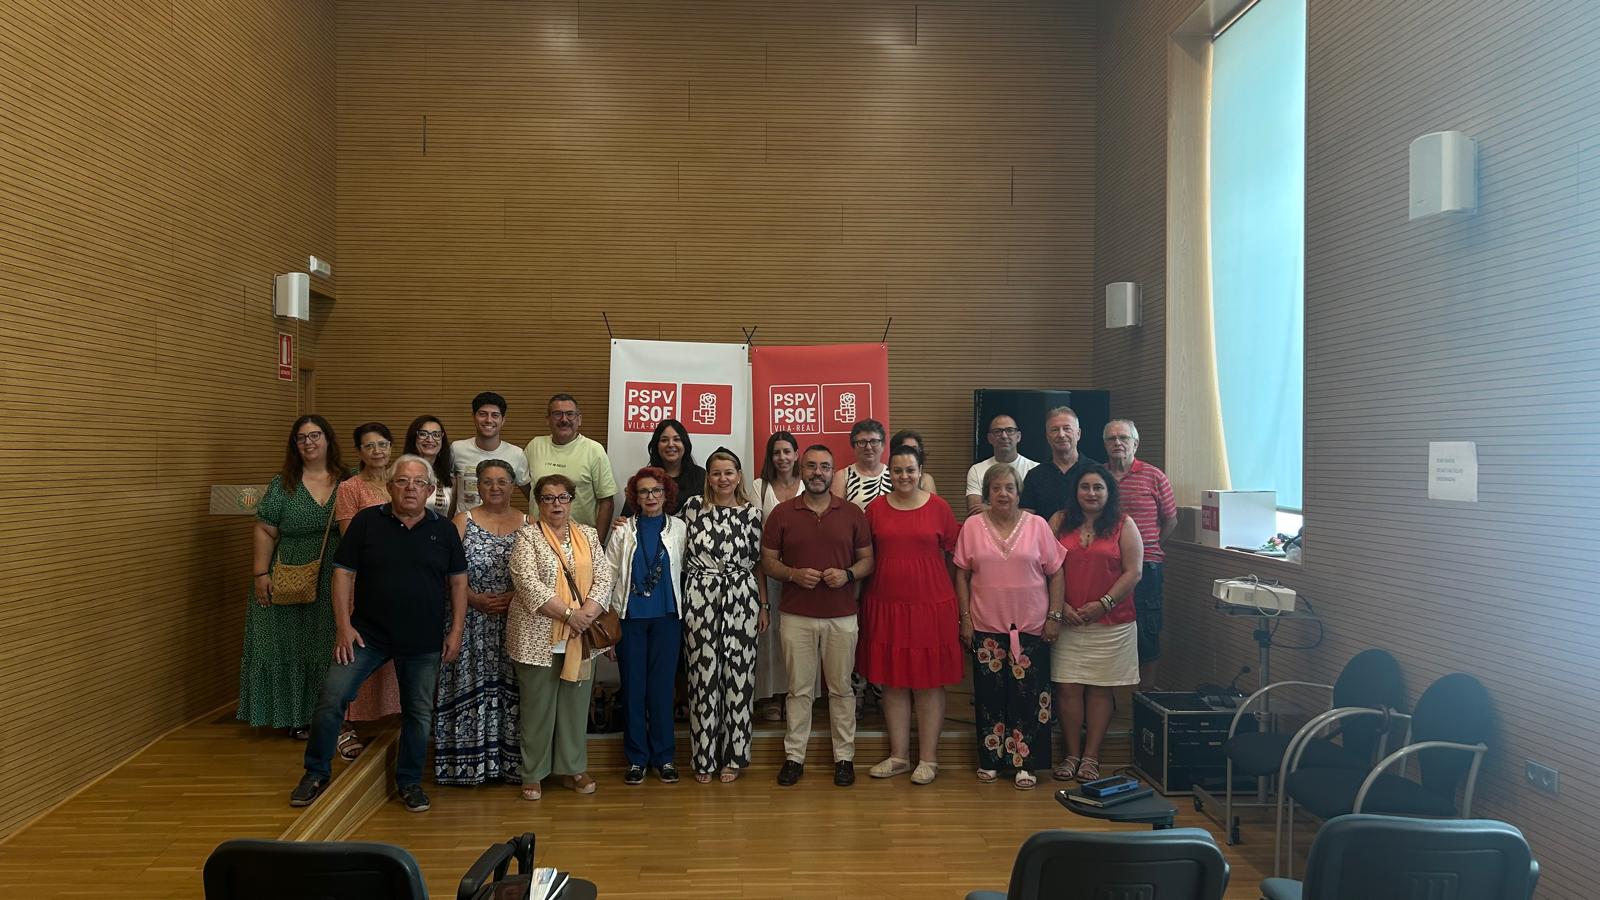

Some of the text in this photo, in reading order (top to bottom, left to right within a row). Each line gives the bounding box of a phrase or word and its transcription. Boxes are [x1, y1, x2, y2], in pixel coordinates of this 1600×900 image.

[628, 389, 675, 404] PSPV
[774, 392, 816, 406] PSPV
[774, 407, 816, 424] PSOE
[628, 422, 660, 430] VILA-RE
[774, 424, 815, 432] VILA-REAL
